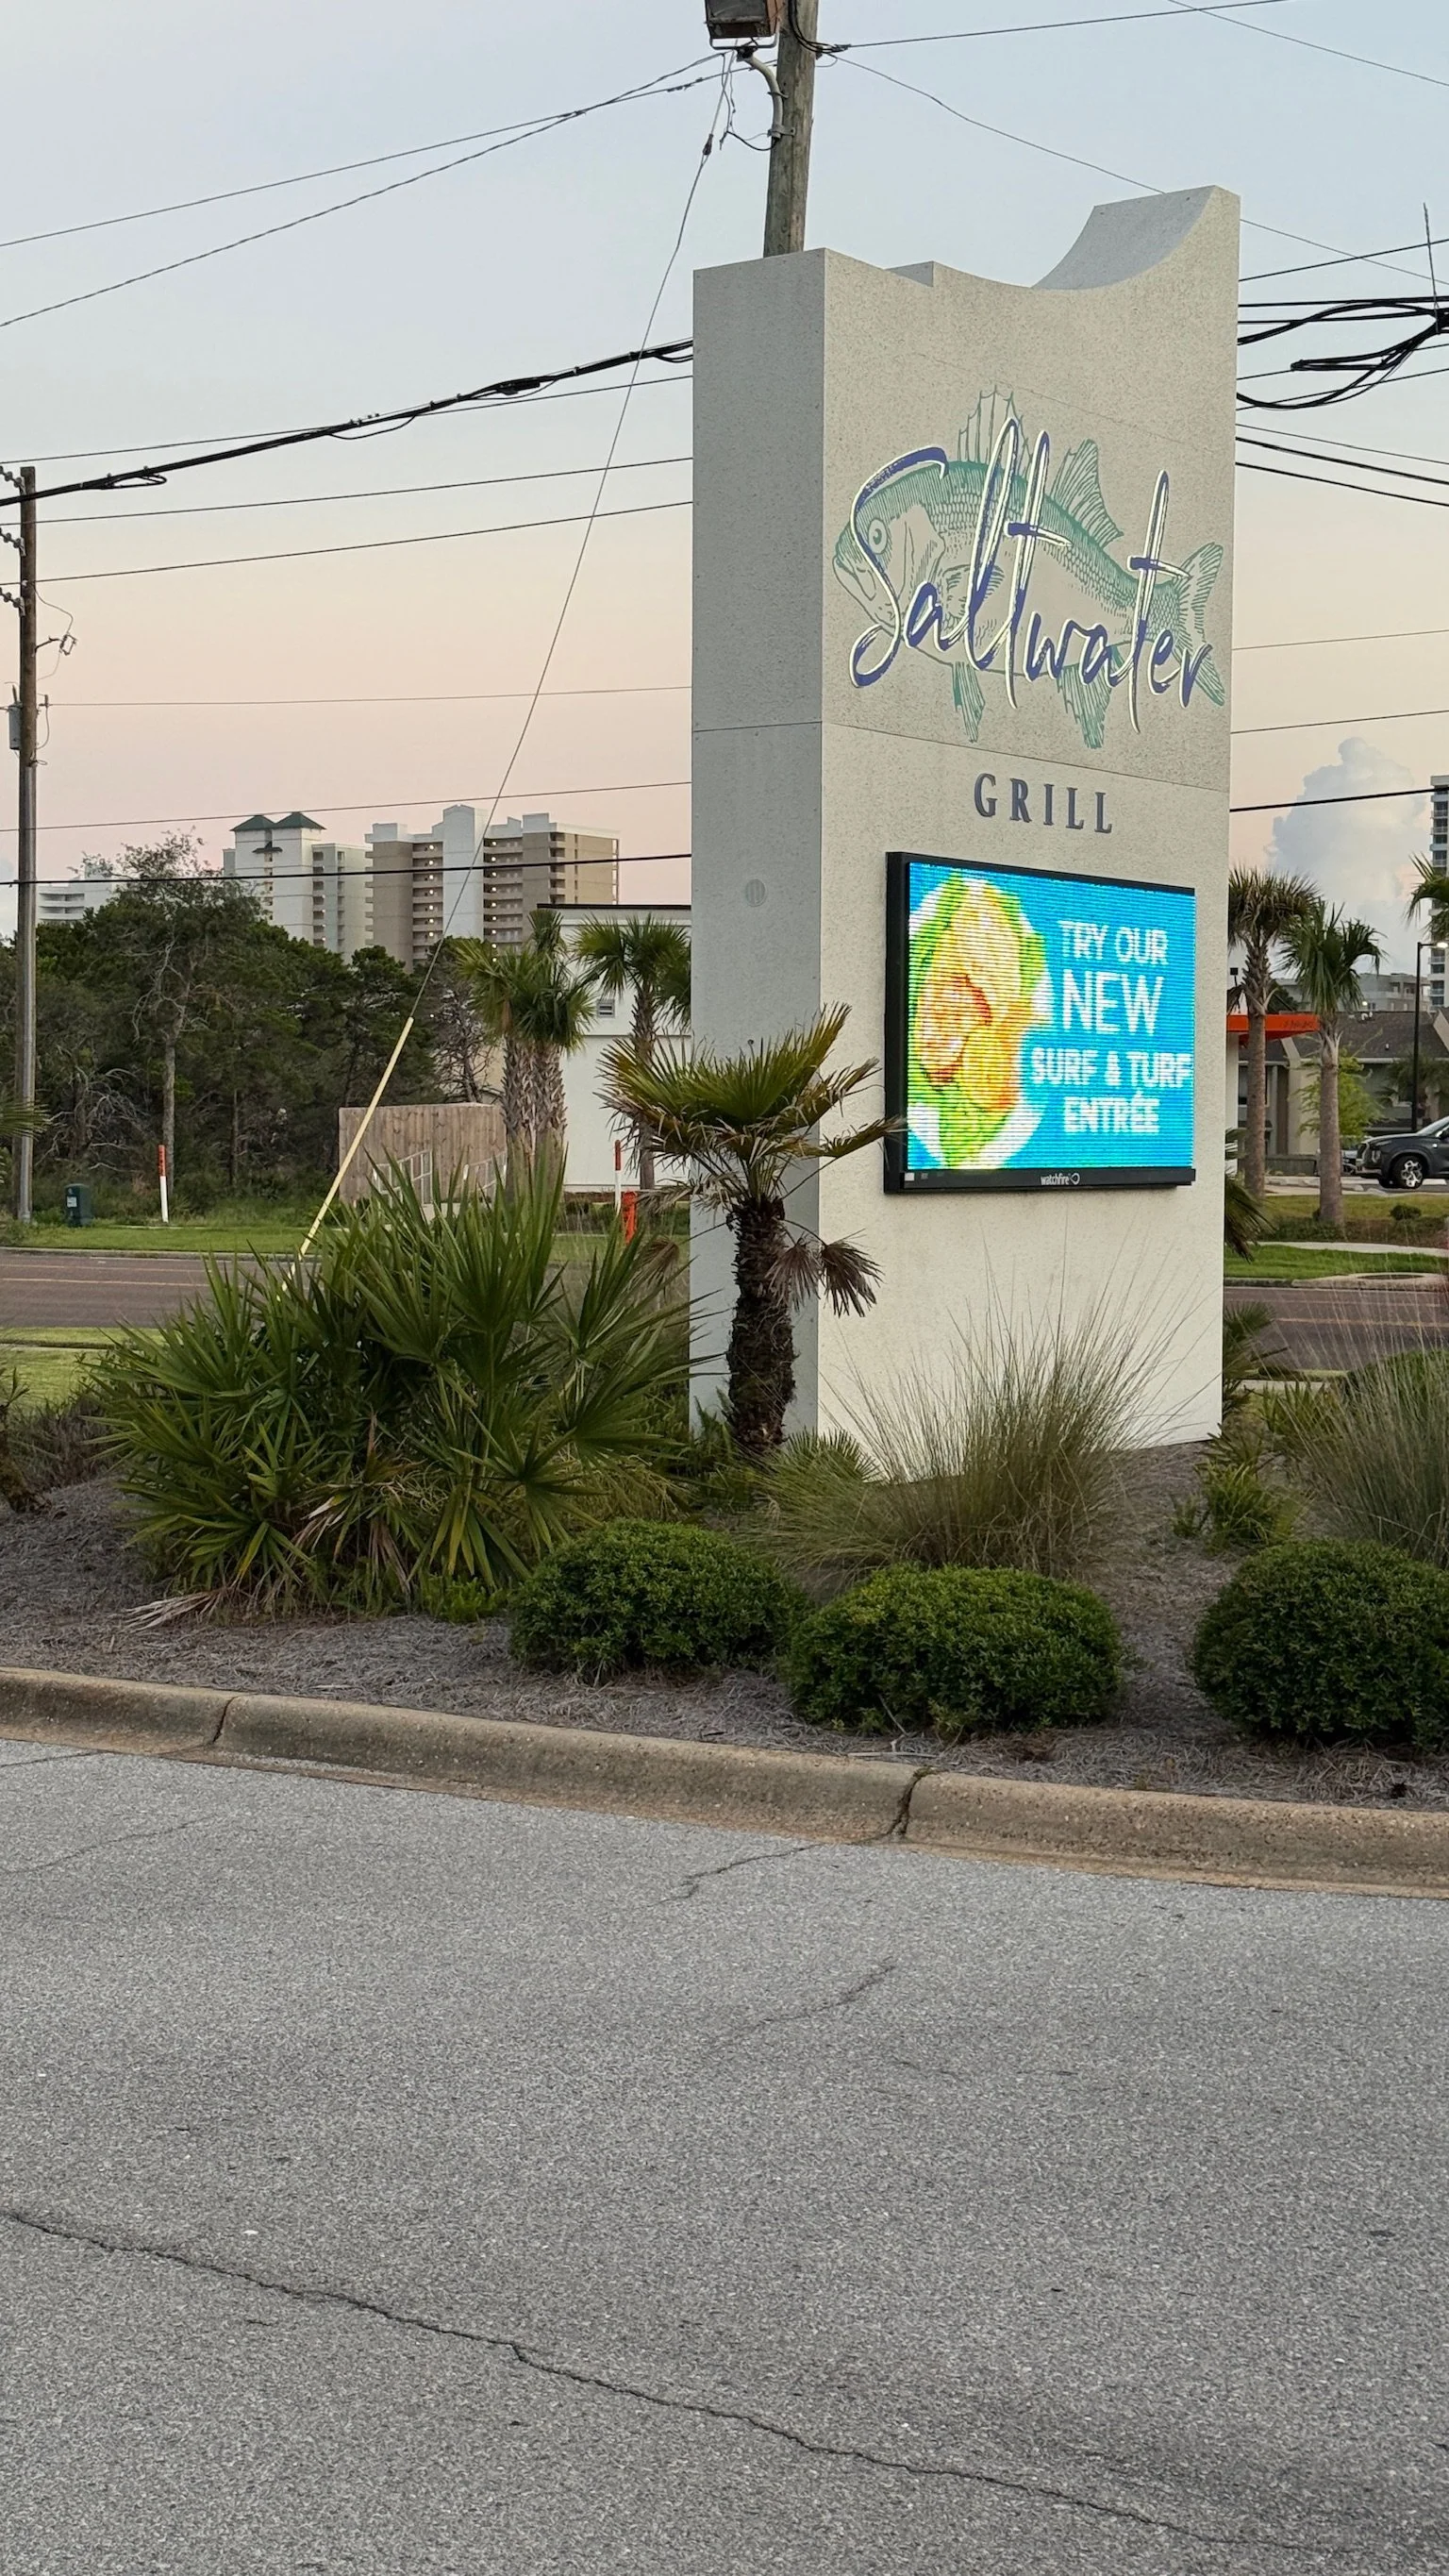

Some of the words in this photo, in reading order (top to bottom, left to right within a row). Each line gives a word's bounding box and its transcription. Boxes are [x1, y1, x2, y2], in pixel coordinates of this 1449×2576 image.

[849, 418, 1212, 733] Saltwater
[974, 773, 1112, 834] GRILL
[1058, 920, 1109, 961] TRY
[1115, 926, 1169, 966] OUR
[1062, 969, 1164, 1036] NEW
[1030, 1047, 1099, 1086] SURF
[1105, 1050, 1122, 1087] &
[1125, 1051, 1194, 1088] TURF
[1063, 1087, 1160, 1134] ENTRÉE
[1041, 1173, 1070, 1186] watchfire
